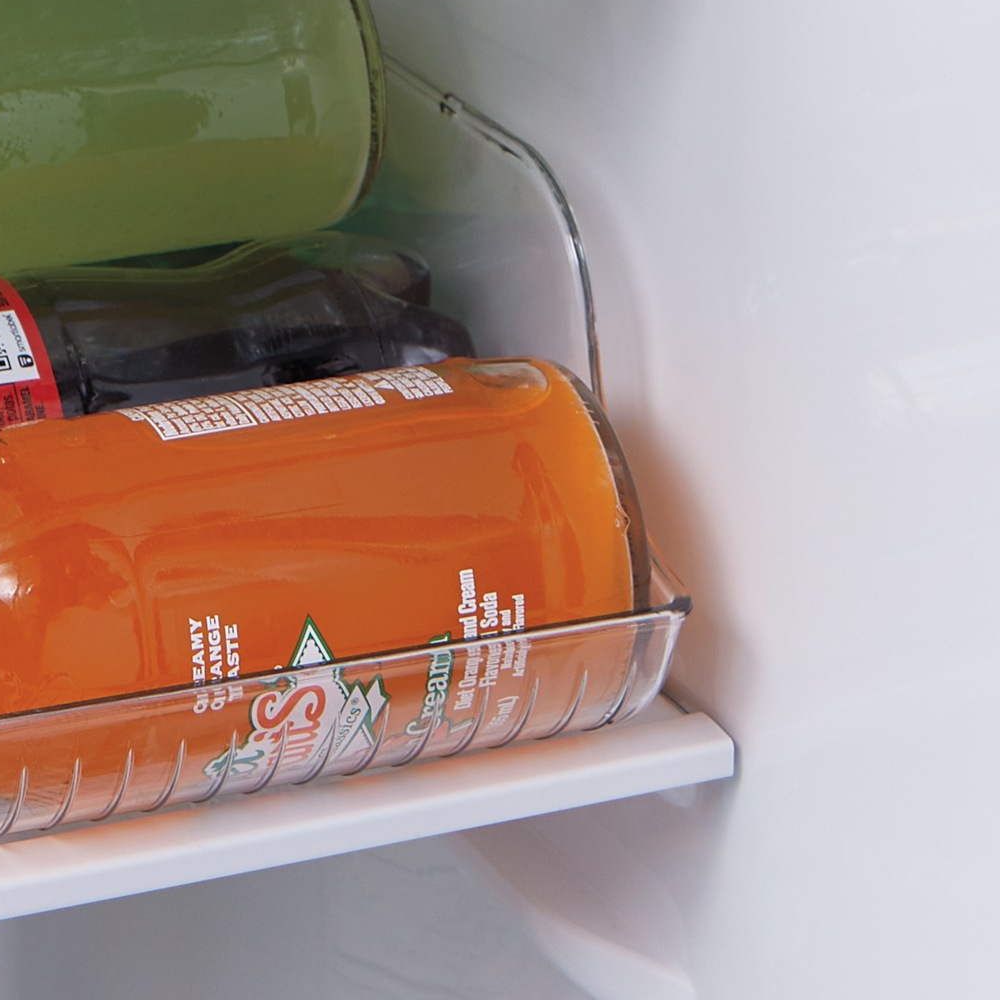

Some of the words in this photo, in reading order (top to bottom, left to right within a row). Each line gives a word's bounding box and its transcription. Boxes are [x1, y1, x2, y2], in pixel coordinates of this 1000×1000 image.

[20, 385, 36, 421] ARAMEL
[457, 568, 478, 615] Cream
[479, 591, 499, 629] Soda
[499, 608, 512, 627] and
[511, 593, 526, 633] Flavored
[454, 687, 475, 711] Diet
